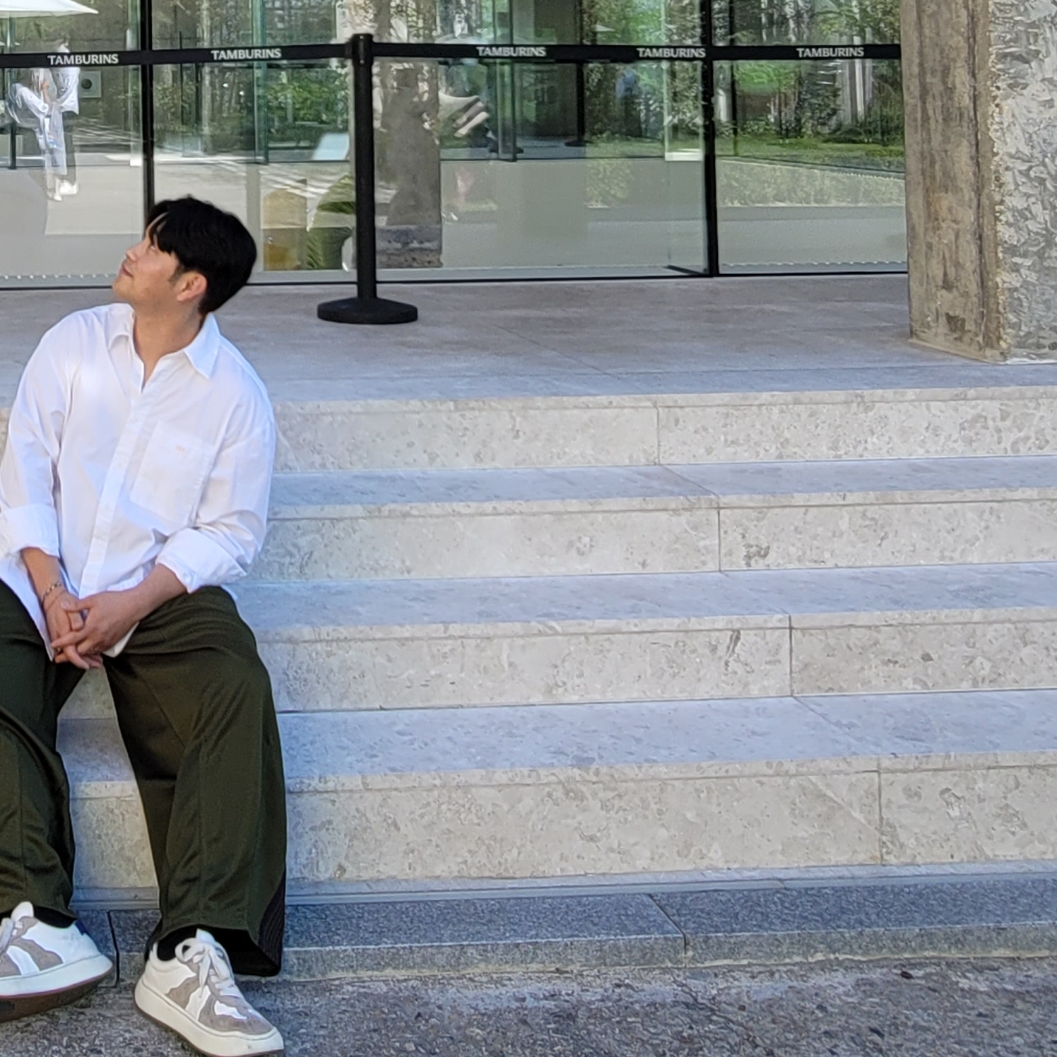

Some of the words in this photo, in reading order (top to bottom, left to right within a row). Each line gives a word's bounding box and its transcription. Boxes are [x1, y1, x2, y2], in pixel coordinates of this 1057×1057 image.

[211, 48, 282, 60] TAMBURINS
[476, 46, 547, 57] TAMBURINS
[636, 47, 706, 59] TAMBURINS
[796, 47, 865, 58] TAMBURINS
[47, 53, 119, 65] TAMBURINS
